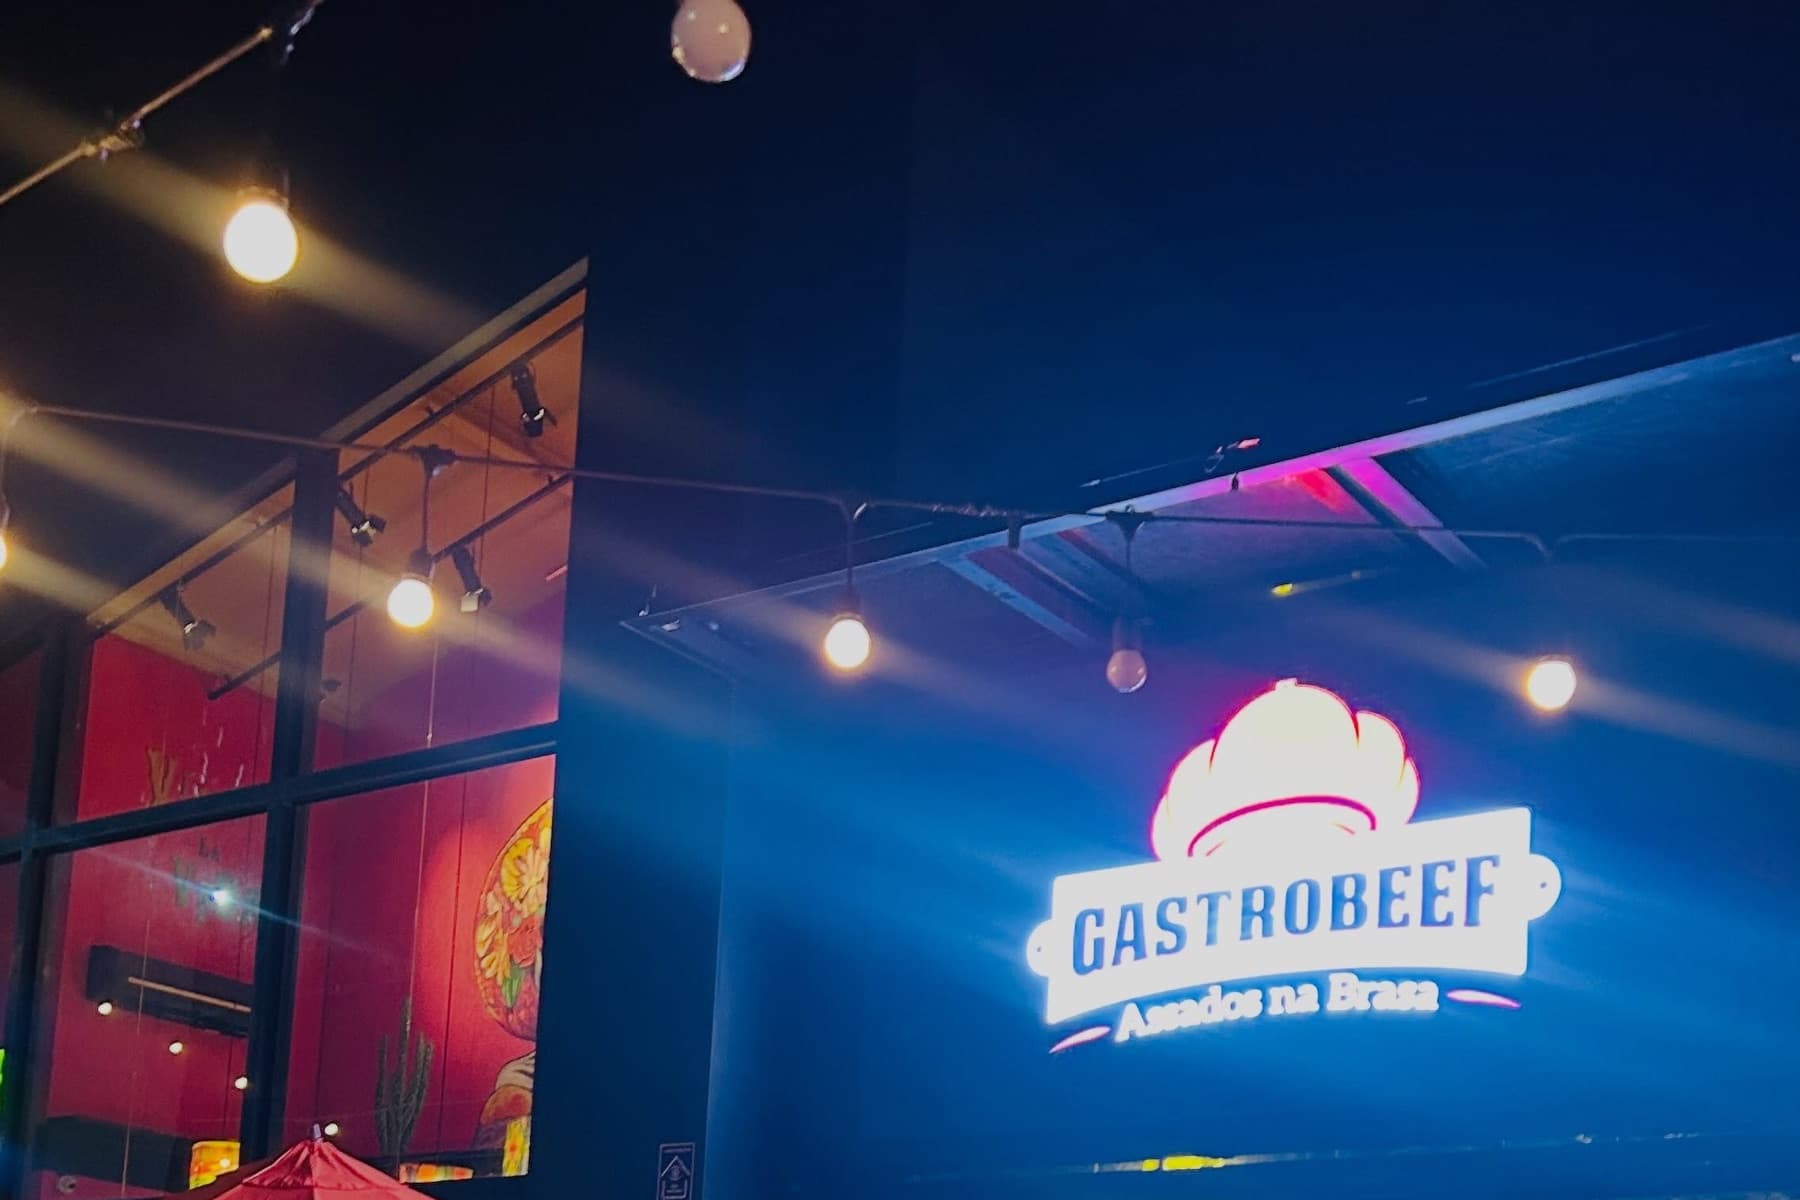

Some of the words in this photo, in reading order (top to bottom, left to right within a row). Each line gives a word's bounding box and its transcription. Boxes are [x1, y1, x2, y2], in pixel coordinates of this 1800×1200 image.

[1072, 854, 1501, 976] GASTROBEEF
[1267, 982, 1320, 1015] na
[1326, 971, 1440, 1012] Brasa
